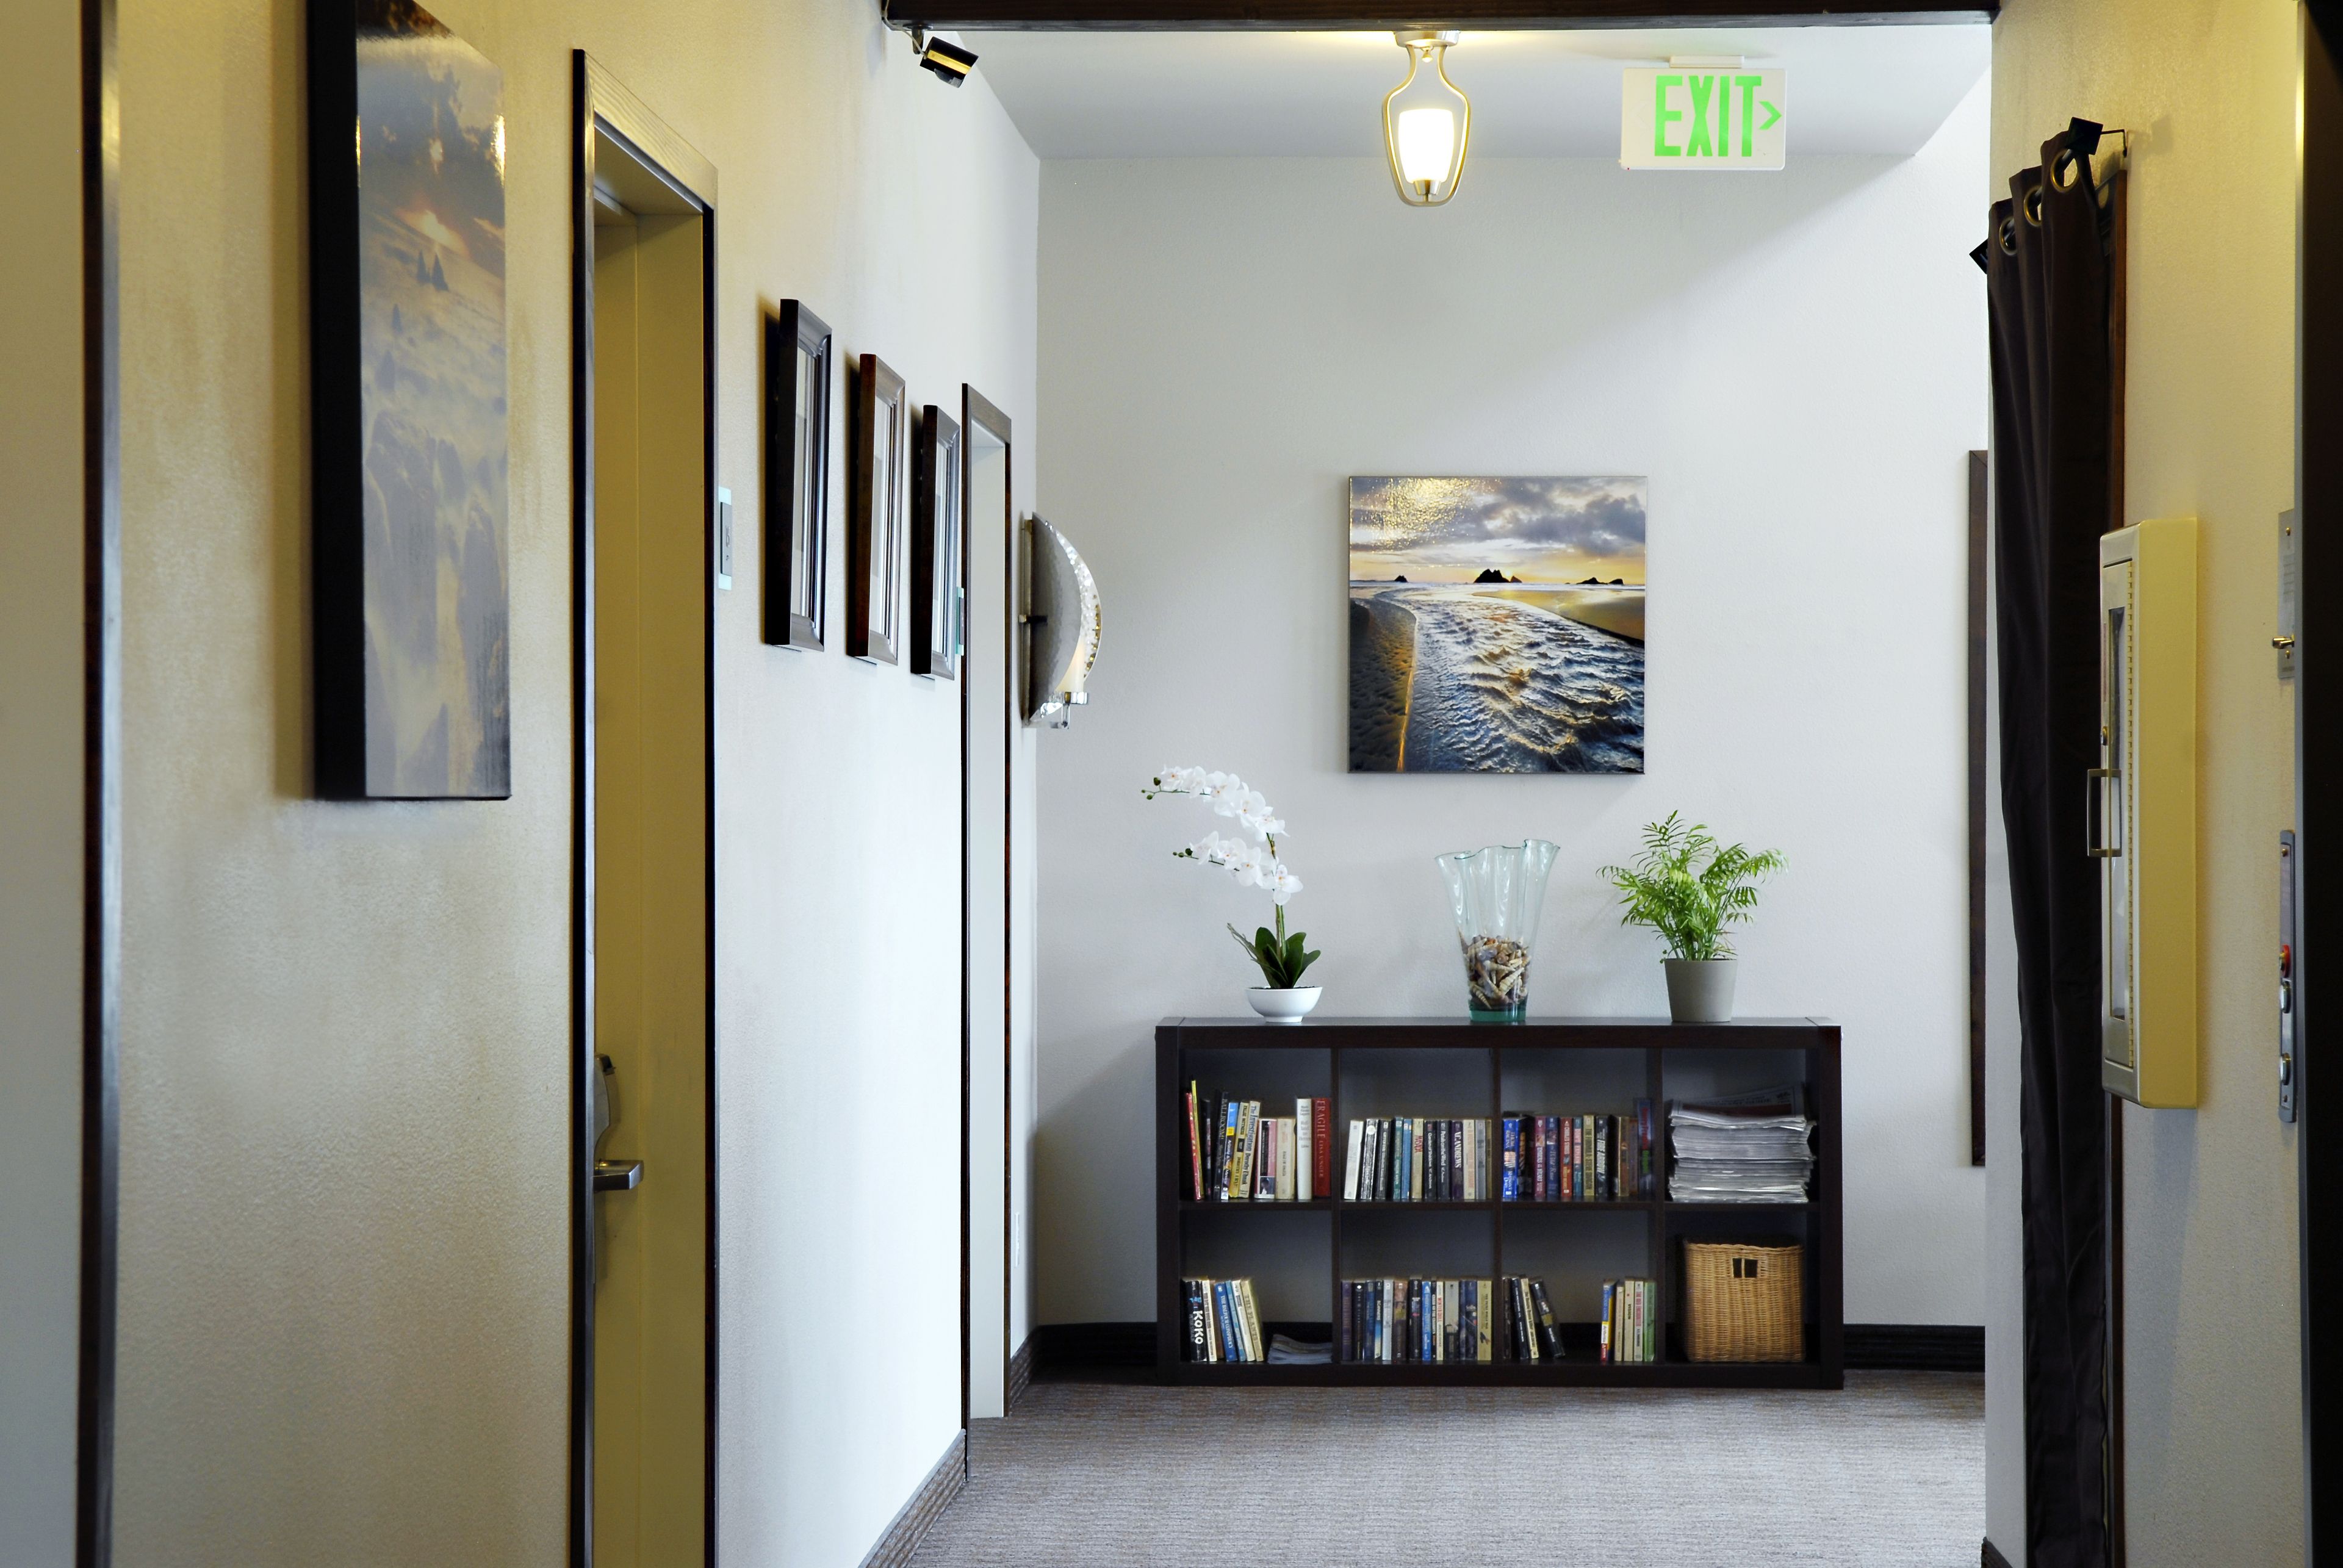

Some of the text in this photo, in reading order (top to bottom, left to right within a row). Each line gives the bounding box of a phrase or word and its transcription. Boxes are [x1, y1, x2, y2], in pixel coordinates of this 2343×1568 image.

[1654, 75, 1762, 157] EXIT
[1247, 1115, 1258, 1152] Investigation
[1316, 1100, 1326, 1138] FRAGILE
[1596, 1139, 1605, 1152] FIRE
[1596, 1151, 1605, 1174] ARROW
[1193, 1311, 1204, 1344] KOKO
[1248, 1311, 1258, 1342] PLANTS
